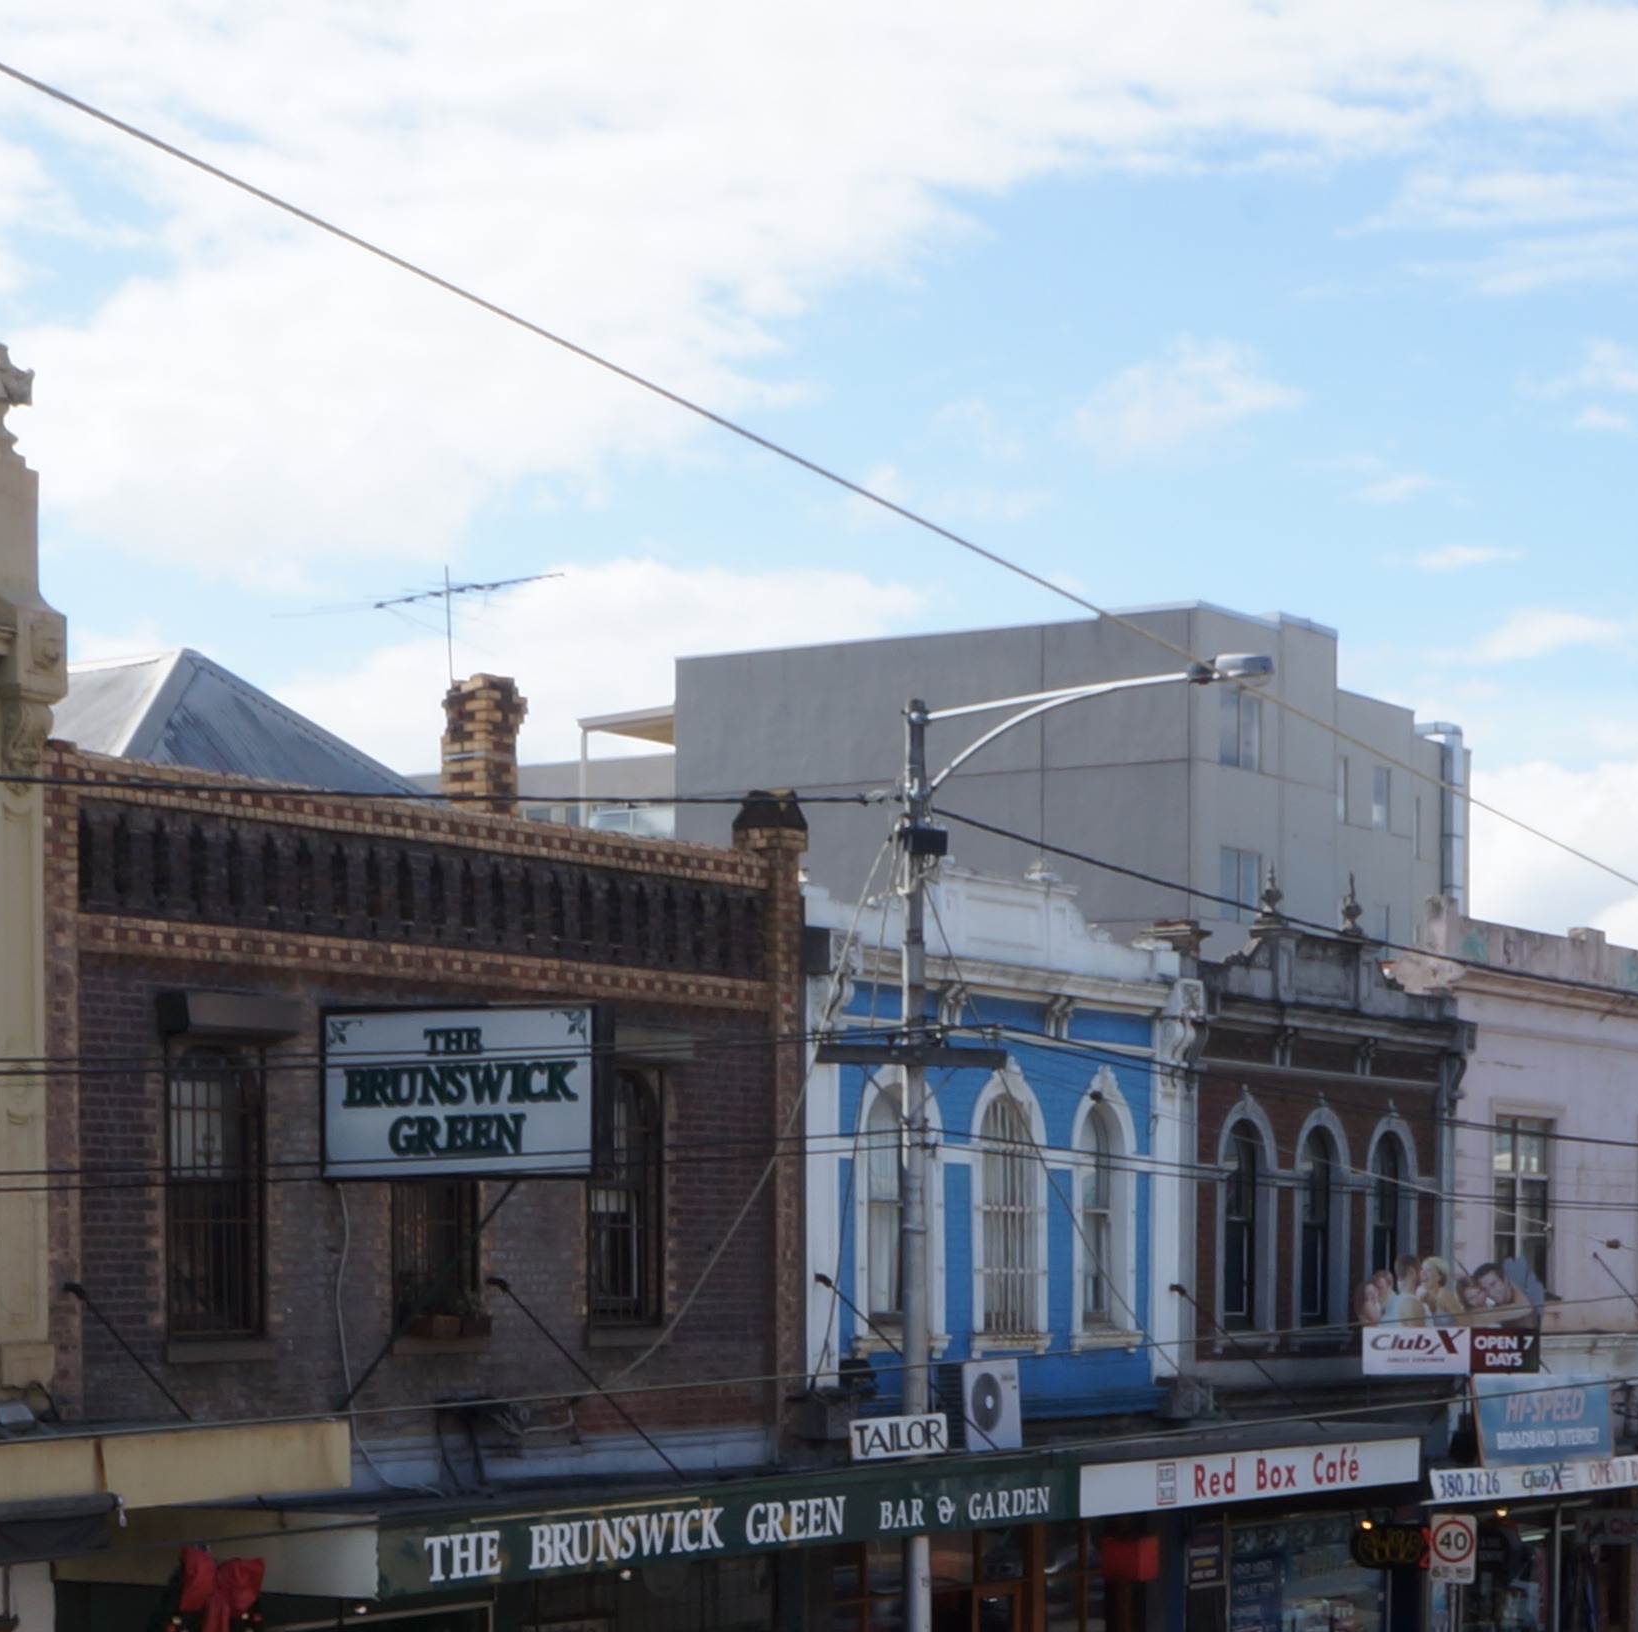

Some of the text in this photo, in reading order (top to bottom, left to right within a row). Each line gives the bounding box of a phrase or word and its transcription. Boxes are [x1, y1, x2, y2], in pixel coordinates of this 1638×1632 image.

[423, 1027, 483, 1056] THE
[342, 1060, 578, 1109] BRUNSWICK
[389, 1113, 526, 1156] GREEN
[1474, 1336, 1533, 1350] OPEN 7
[1485, 1352, 1523, 1367] DAYS
[1506, 1388, 1586, 1423] HI-SPEED
[854, 1420, 950, 1456] TAILOR
[1496, 1427, 1599, 1450] BROADBAND INTERNET
[1194, 1457, 1236, 1497] Red
[1256, 1457, 1296, 1490] Box
[1313, 1446, 1359, 1485] Café
[1589, 1459, 1619, 1485] OPEN
[1621, 1458, 1628, 1481] 7
[424, 1486, 1050, 1583] THE BRUNSWICK GREEN BAR & GARDEN
[1439, 1532, 1467, 1551] 40
